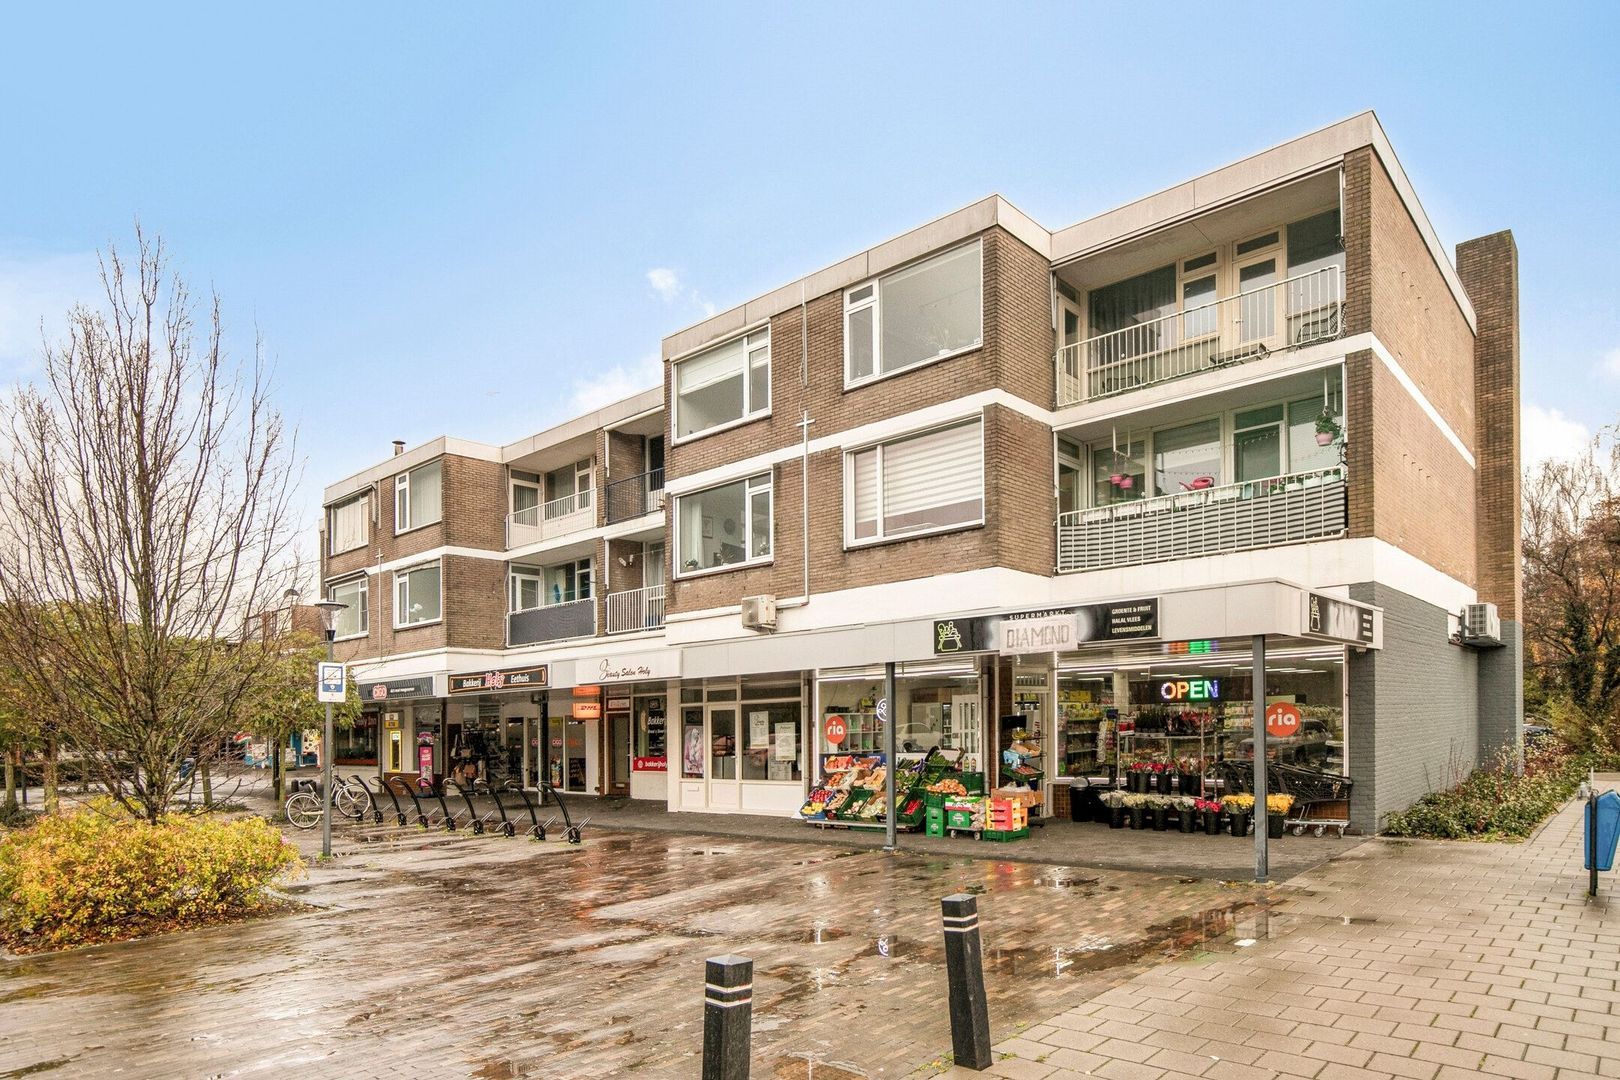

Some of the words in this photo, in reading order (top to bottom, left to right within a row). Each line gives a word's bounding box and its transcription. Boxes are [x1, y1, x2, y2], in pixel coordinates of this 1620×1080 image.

[1009, 609, 1066, 620] SUPERMARKT
[1111, 625, 1152, 634] LEVENSMIDDELEN
[621, 668, 636, 677] Salon
[462, 678, 482, 688] Bakkerij
[510, 674, 530, 683] Eethuis
[1160, 679, 1219, 700] OPEN
[1268, 707, 1296, 727] ria
[827, 720, 844, 735] ria
